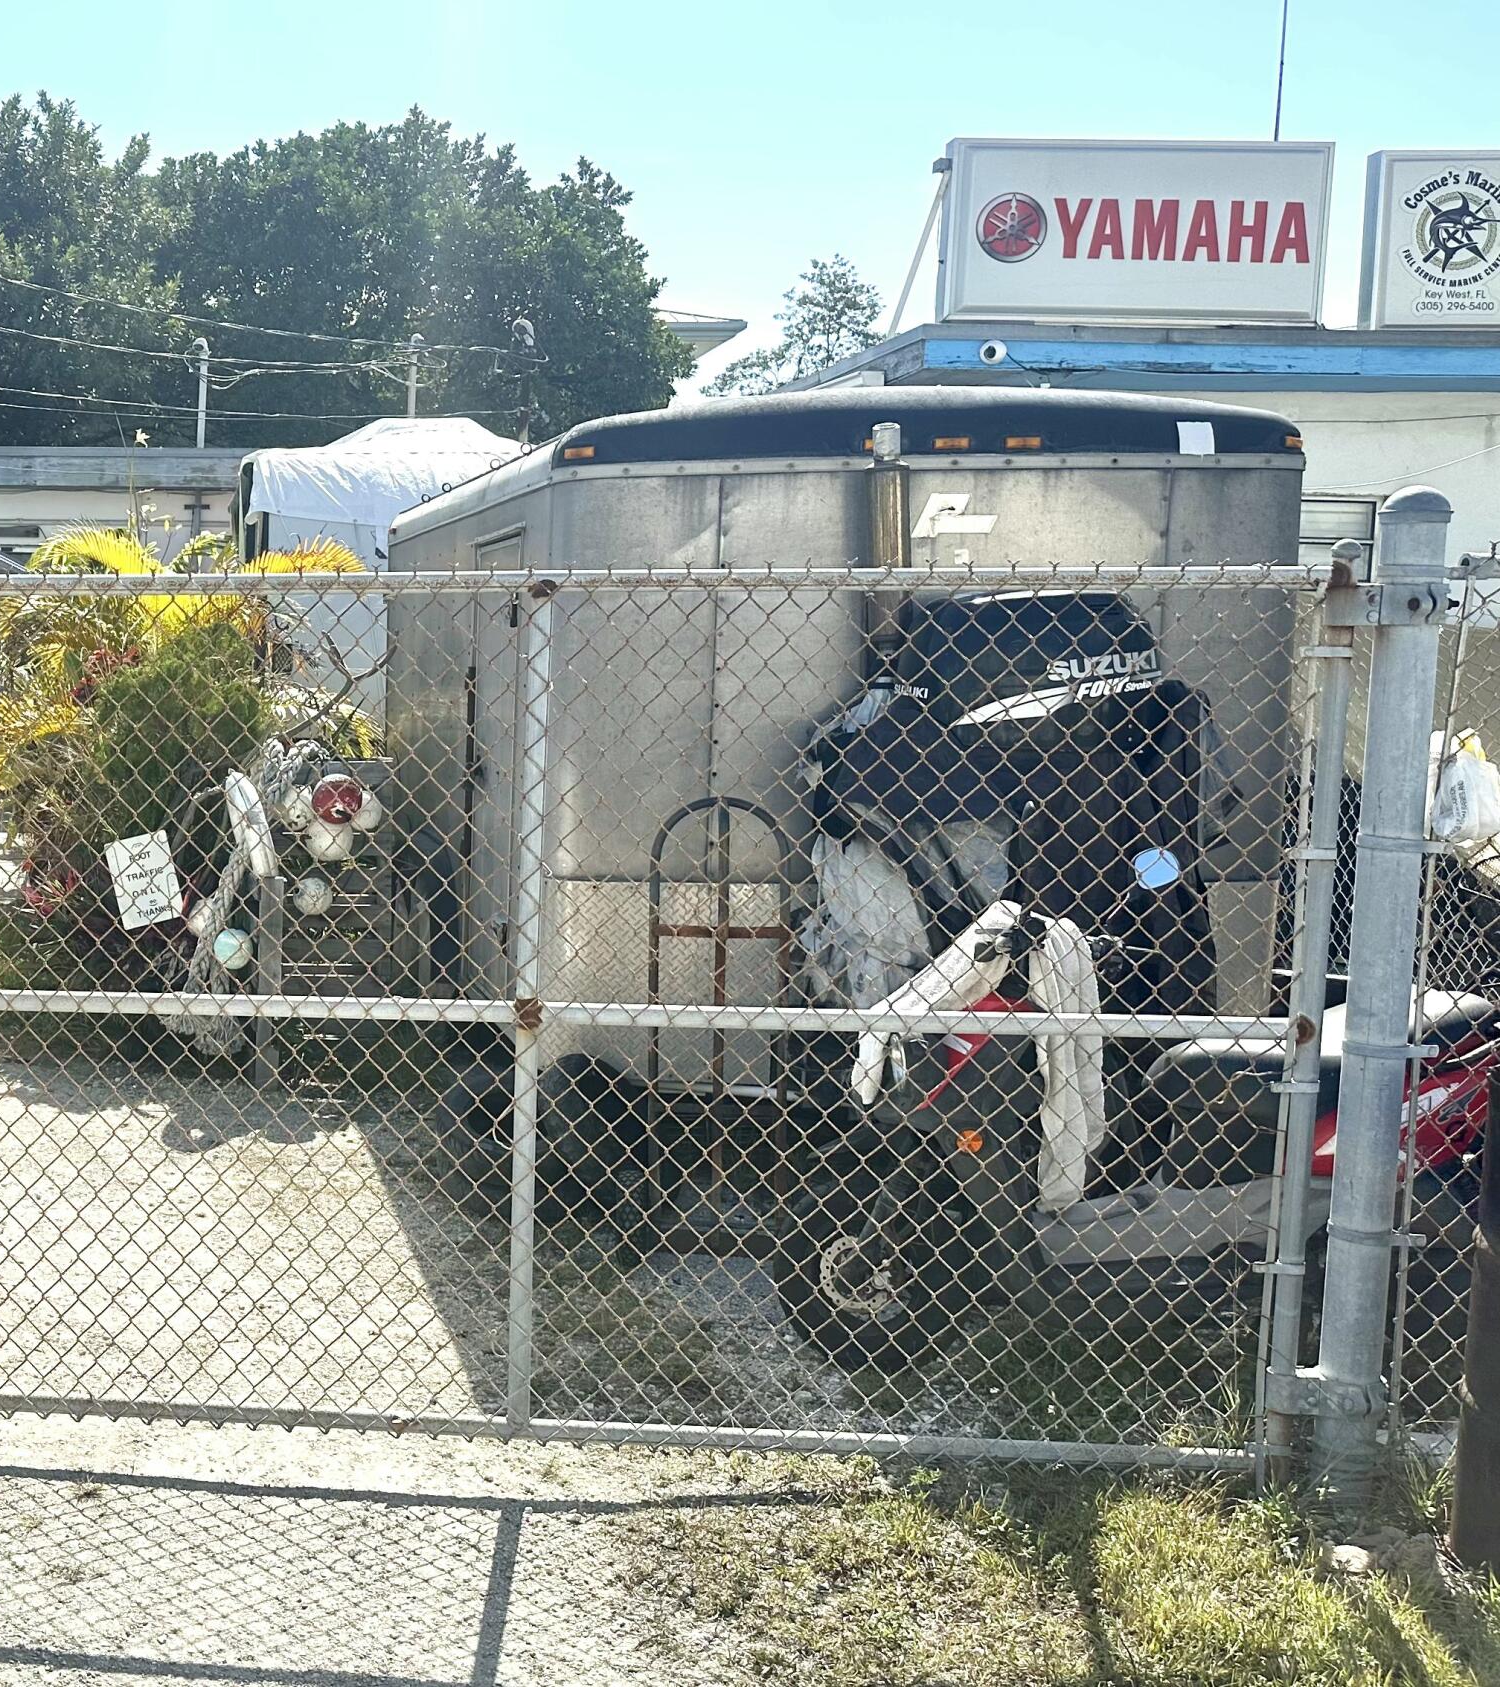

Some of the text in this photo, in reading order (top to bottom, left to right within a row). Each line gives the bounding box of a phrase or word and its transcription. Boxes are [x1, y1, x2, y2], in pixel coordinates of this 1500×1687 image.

[1404, 171, 1461, 210] Cosme's
[1053, 197, 1311, 265] YAMAHA
[1402, 249, 1417, 268] FULL
[1414, 266, 1447, 287] SERVICE
[1449, 273, 1484, 288] MARINE
[1415, 301, 1495, 313] (305) 296-5400
[1425, 289, 1443, 300] Key
[1476, 289, 1487, 299] FL
[1046, 648, 1157, 682] SUZUKI
[129, 851, 151, 862] FOOT
[126, 866, 164, 882] TRAFFIC
